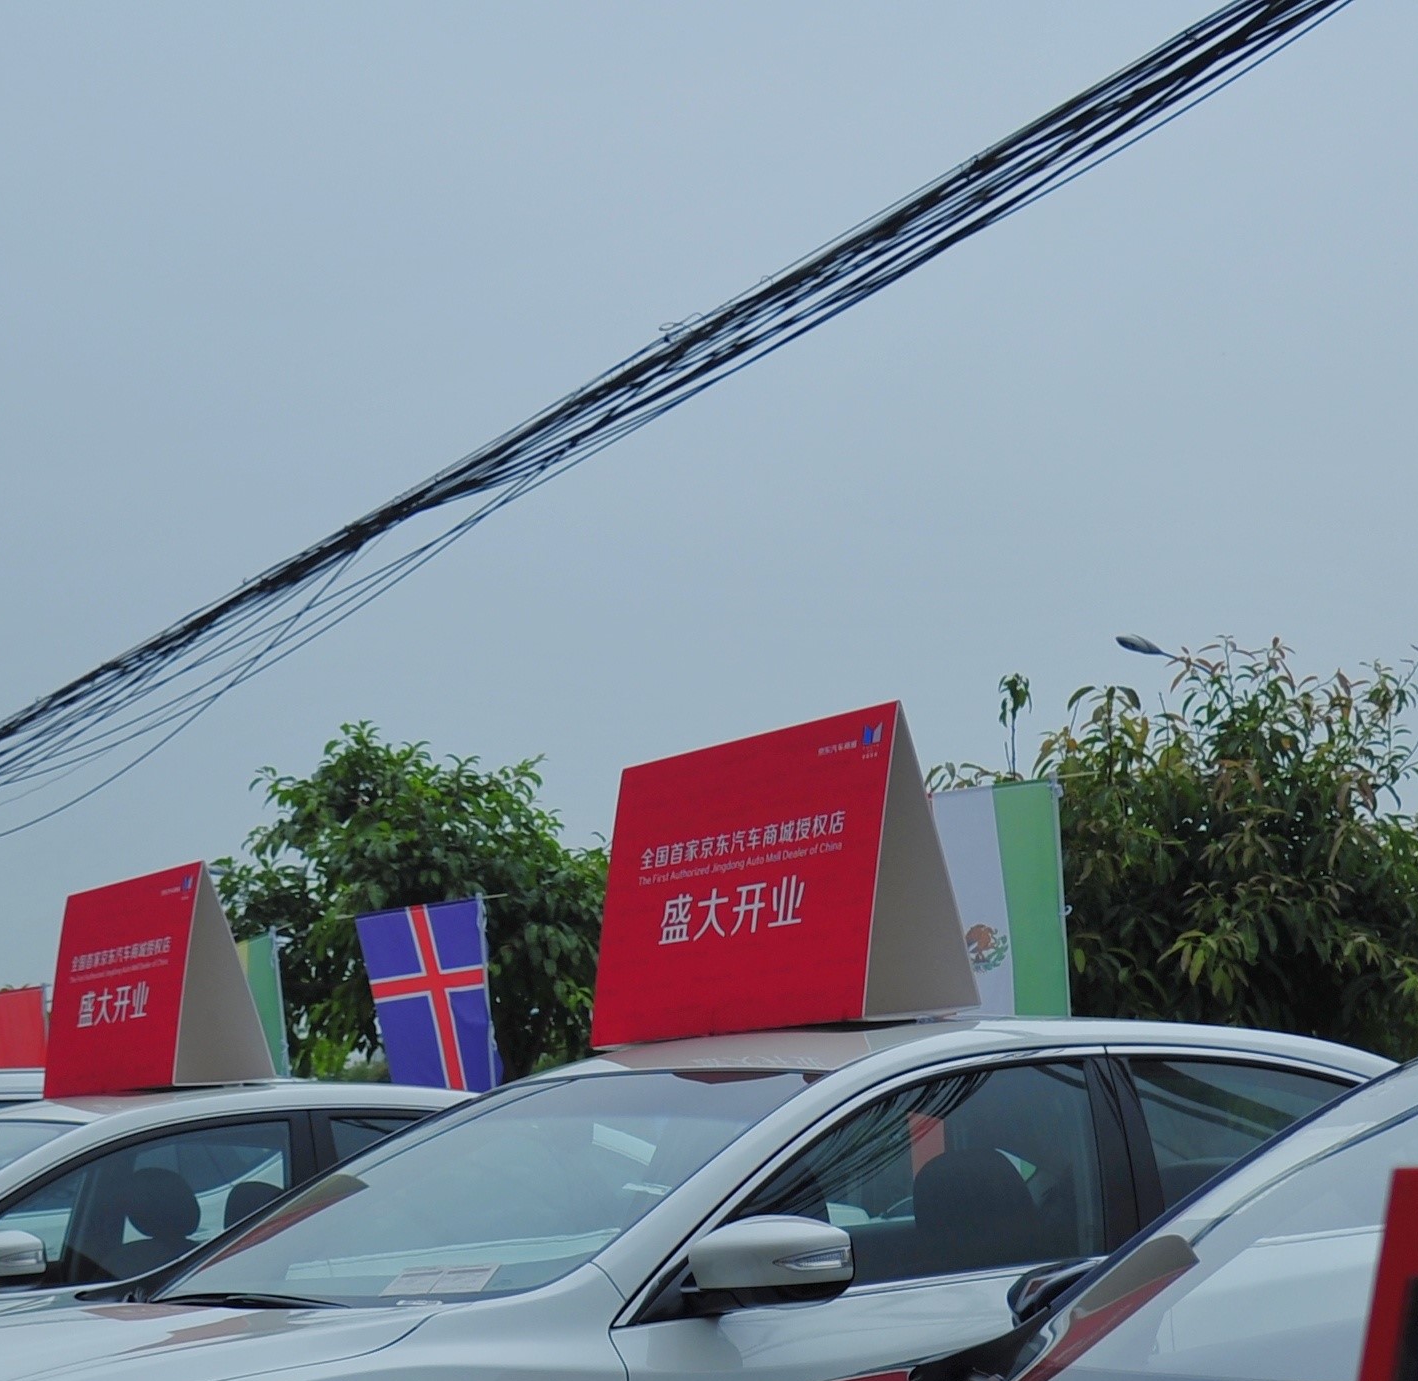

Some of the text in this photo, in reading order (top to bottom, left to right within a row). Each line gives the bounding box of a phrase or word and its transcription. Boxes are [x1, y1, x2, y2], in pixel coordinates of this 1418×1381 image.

[638, 876, 652, 887] The
[652, 873, 670, 885] First
[670, 866, 710, 882] Authorized
[746, 855, 765, 867] Auto
[819, 841, 843, 854] China
[640, 810, 846, 870] 全国首家京东汽车商城授权店
[658, 874, 805, 945] 盛大开业
[77, 981, 150, 1028] 盛大开业
